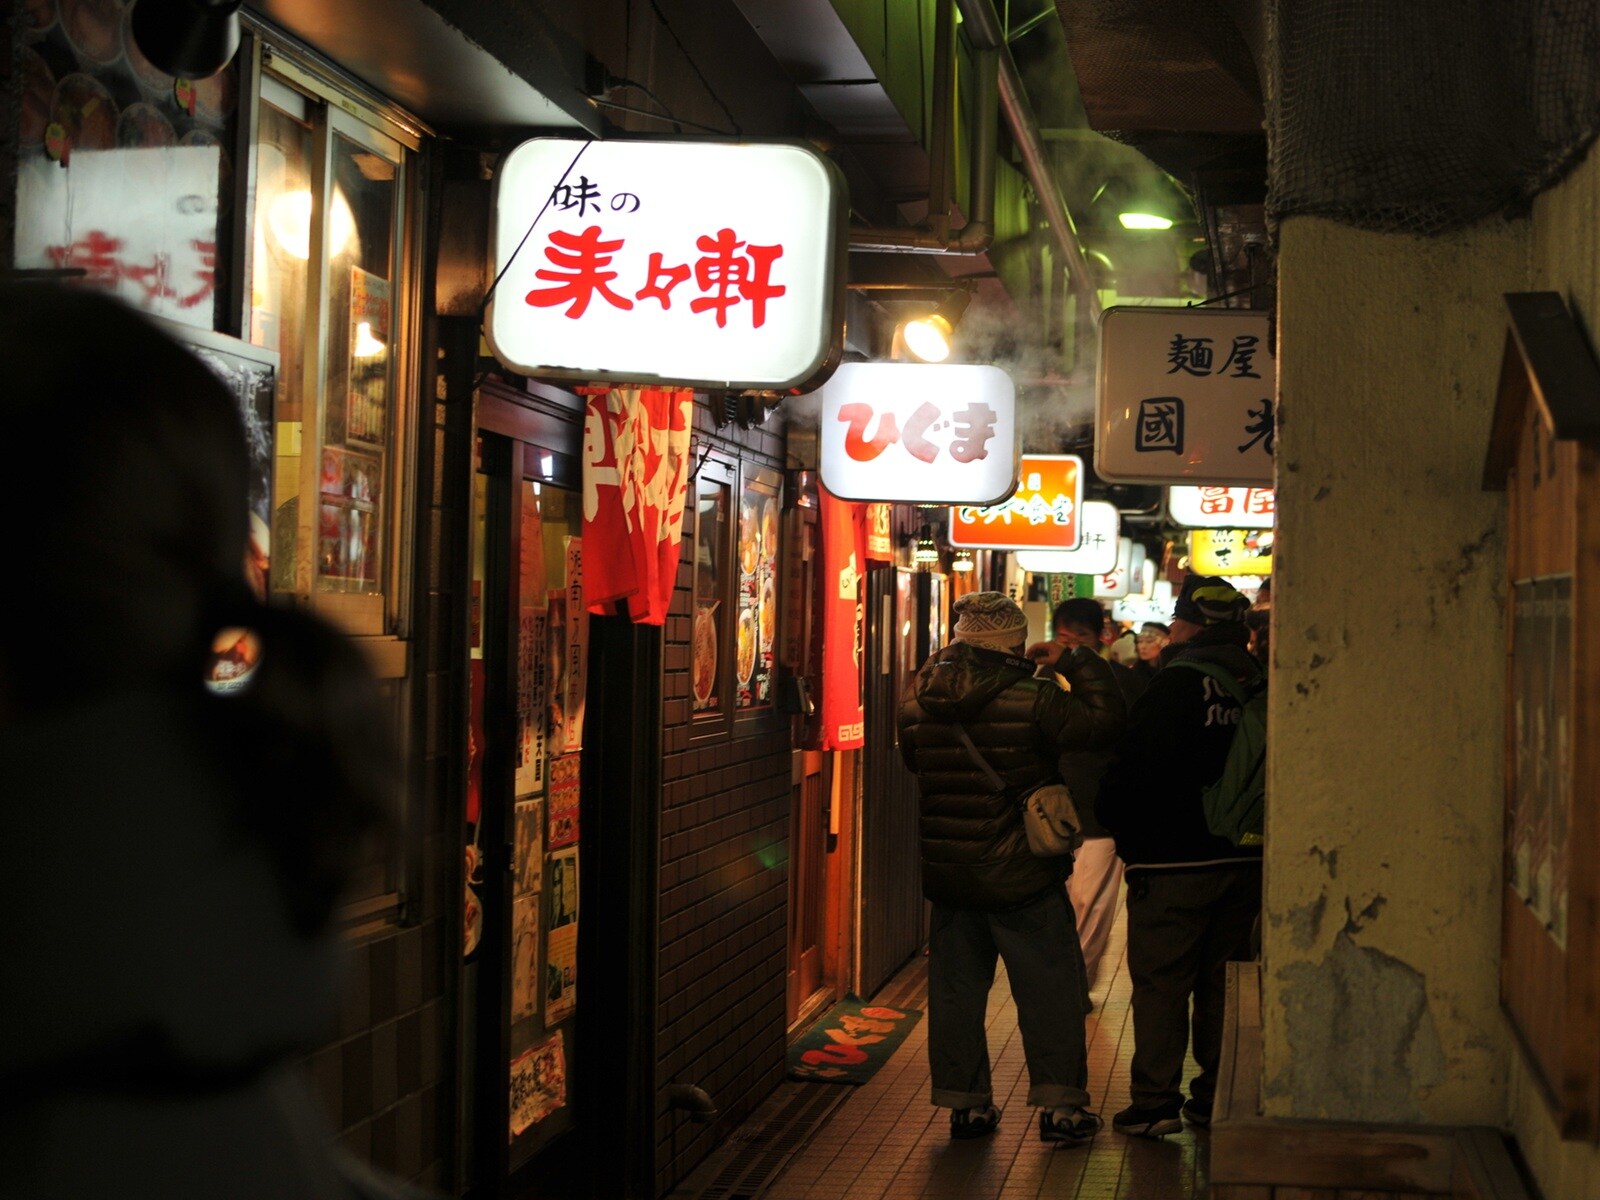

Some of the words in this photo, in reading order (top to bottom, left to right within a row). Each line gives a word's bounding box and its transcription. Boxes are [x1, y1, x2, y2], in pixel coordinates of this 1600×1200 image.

[551, 176, 641, 217] 味の
[524, 225, 787, 329] 来々軒
[1166, 334, 1262, 378] 麺屋
[837, 401, 998, 464] ひぐま
